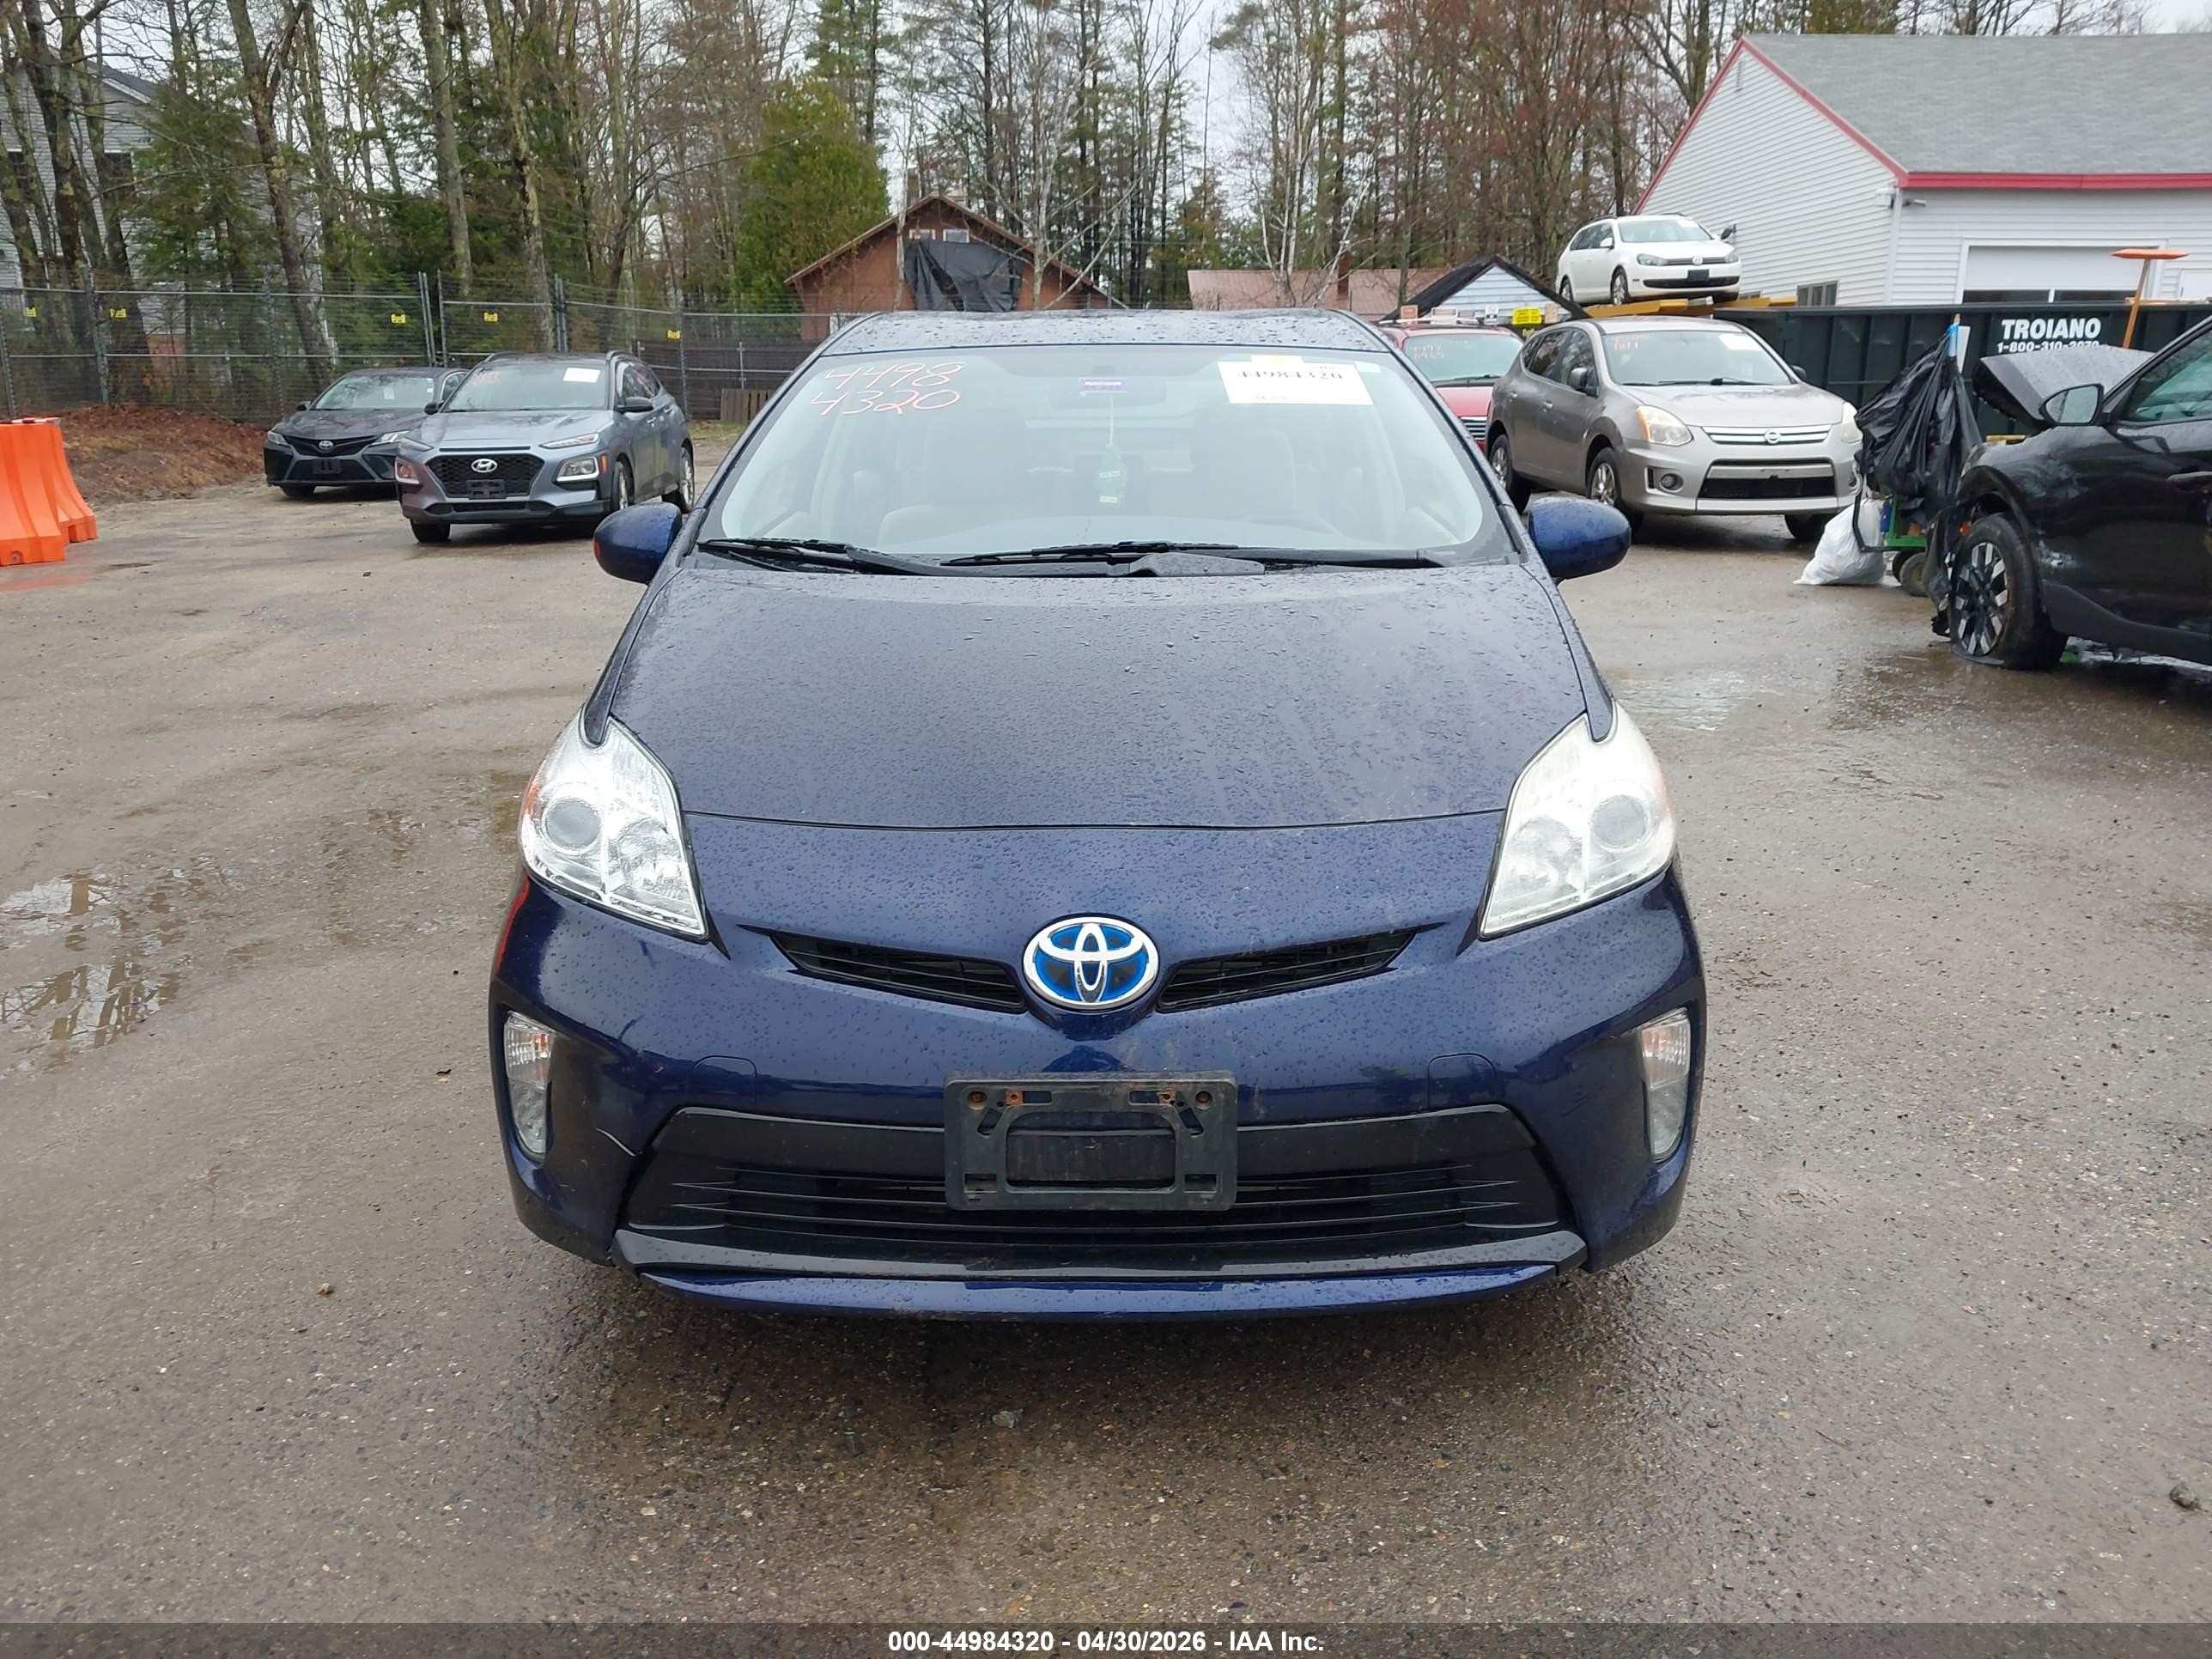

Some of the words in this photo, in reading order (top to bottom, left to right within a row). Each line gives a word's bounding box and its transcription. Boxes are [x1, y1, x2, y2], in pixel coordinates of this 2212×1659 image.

[2002, 318, 2101, 340] TROIANO
[824, 362, 967, 391] 4498
[811, 389, 961, 416] 4320
